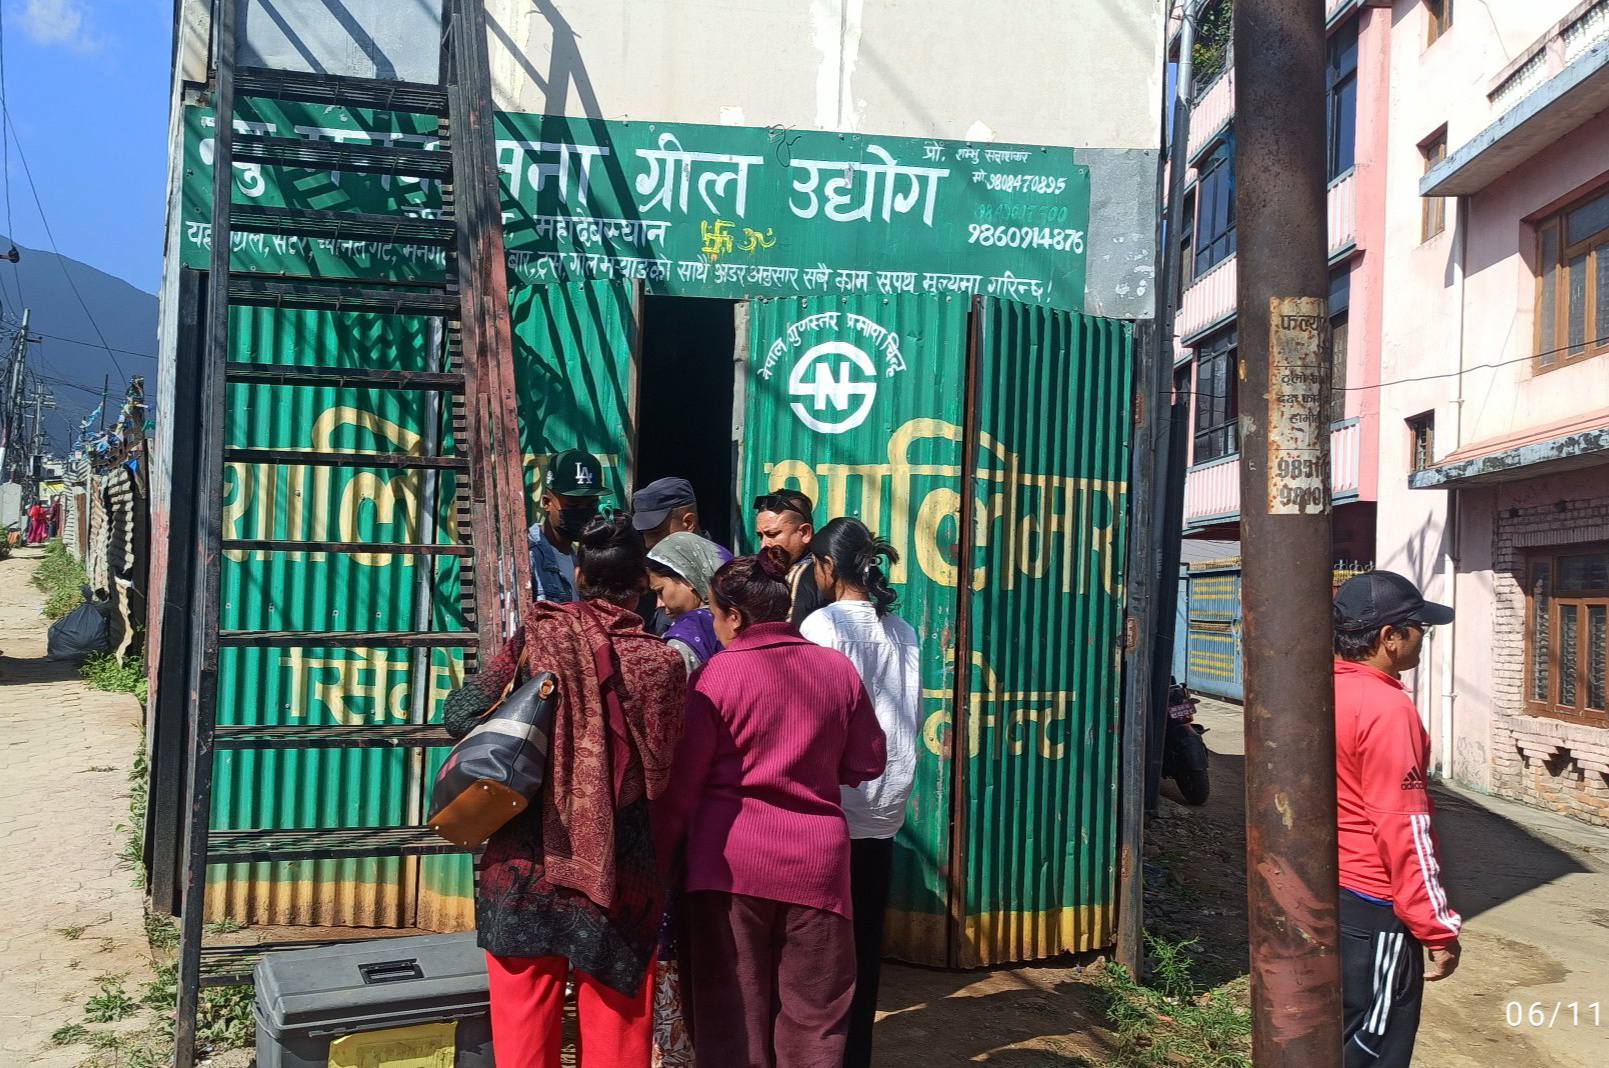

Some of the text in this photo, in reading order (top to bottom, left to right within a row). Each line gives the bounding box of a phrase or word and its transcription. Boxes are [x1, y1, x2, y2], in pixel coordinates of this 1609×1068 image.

[635, 132, 764, 219] ग्रील
[789, 144, 950, 227] उद्योग
[968, 224, 1084, 254] 9860914876
[835, 269, 873, 293] काम
[1400, 781, 1425, 792] adida
